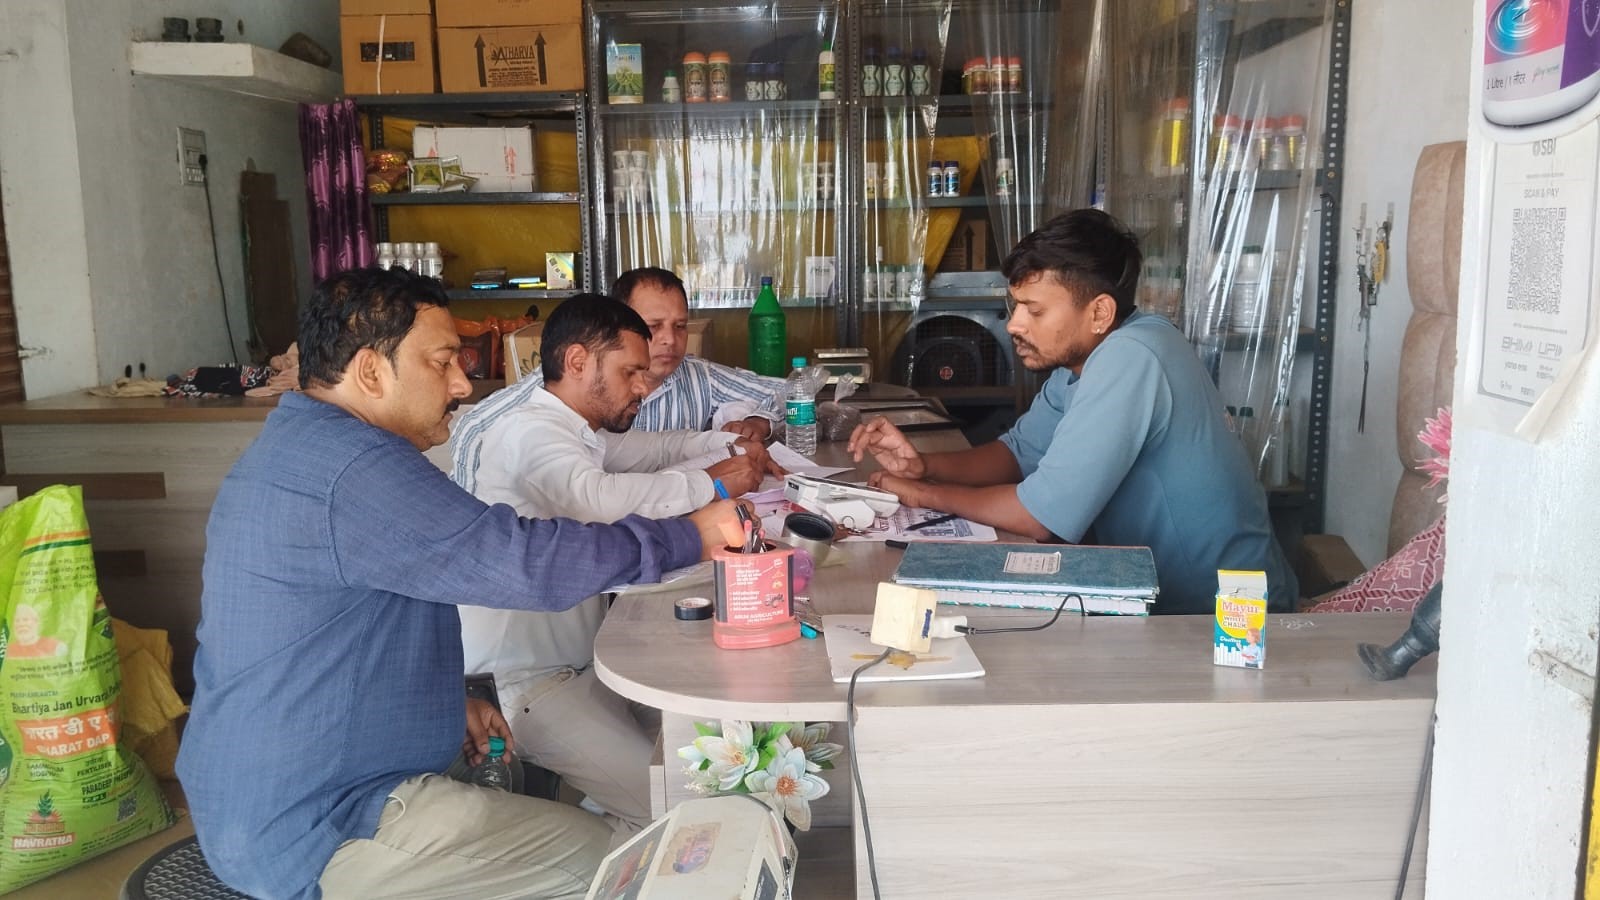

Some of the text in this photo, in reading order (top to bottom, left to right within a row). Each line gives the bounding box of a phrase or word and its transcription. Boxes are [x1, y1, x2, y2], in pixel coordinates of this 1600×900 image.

[1546, 187, 1560, 198] PAY
[1222, 600, 1259, 614] Mayur
[1222, 621, 1248, 629] CHALK
[53, 701, 73, 711] Jan
[88, 734, 110, 748] DAP
